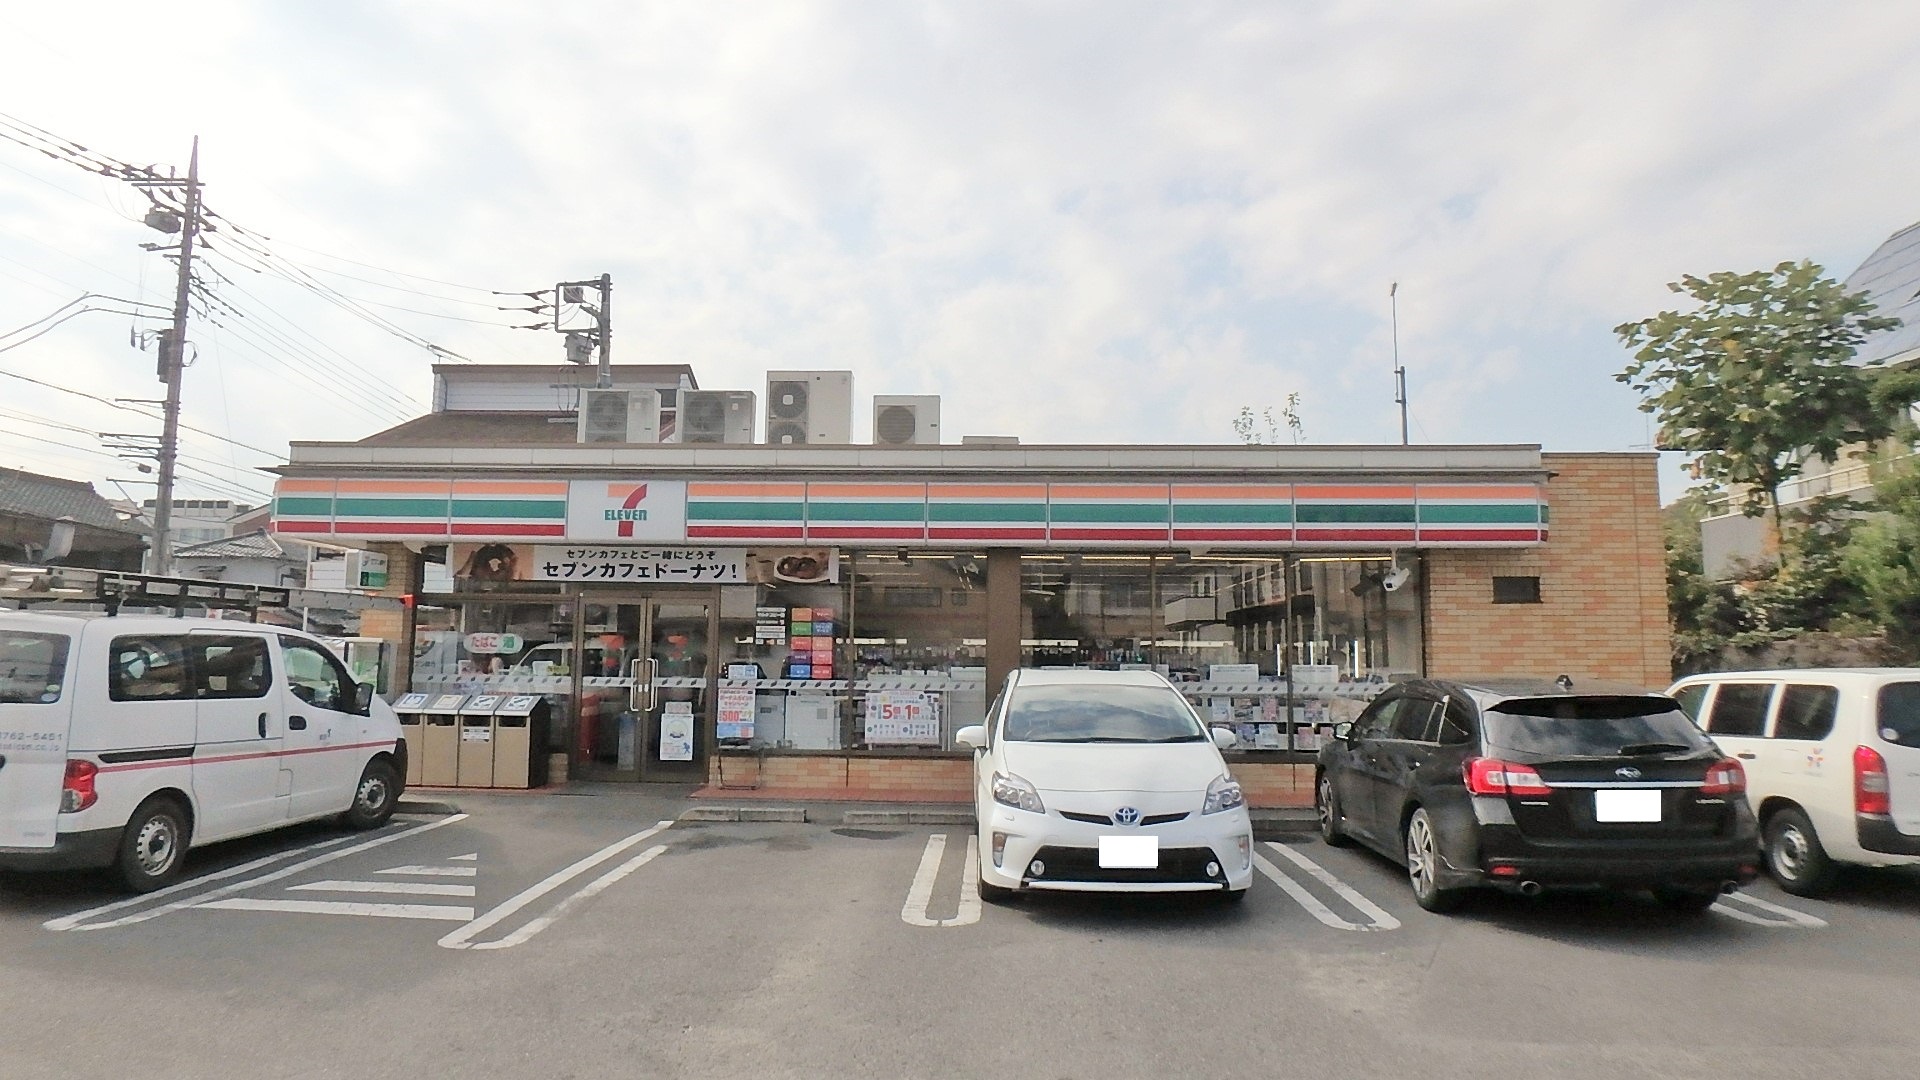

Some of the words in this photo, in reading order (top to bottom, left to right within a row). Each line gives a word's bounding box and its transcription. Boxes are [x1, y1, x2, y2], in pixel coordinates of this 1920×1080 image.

[608, 483, 648, 537] 7
[565, 549, 717, 560] セブンカフェとご一緒にどうぞ
[722, 710, 740, 721] 500
